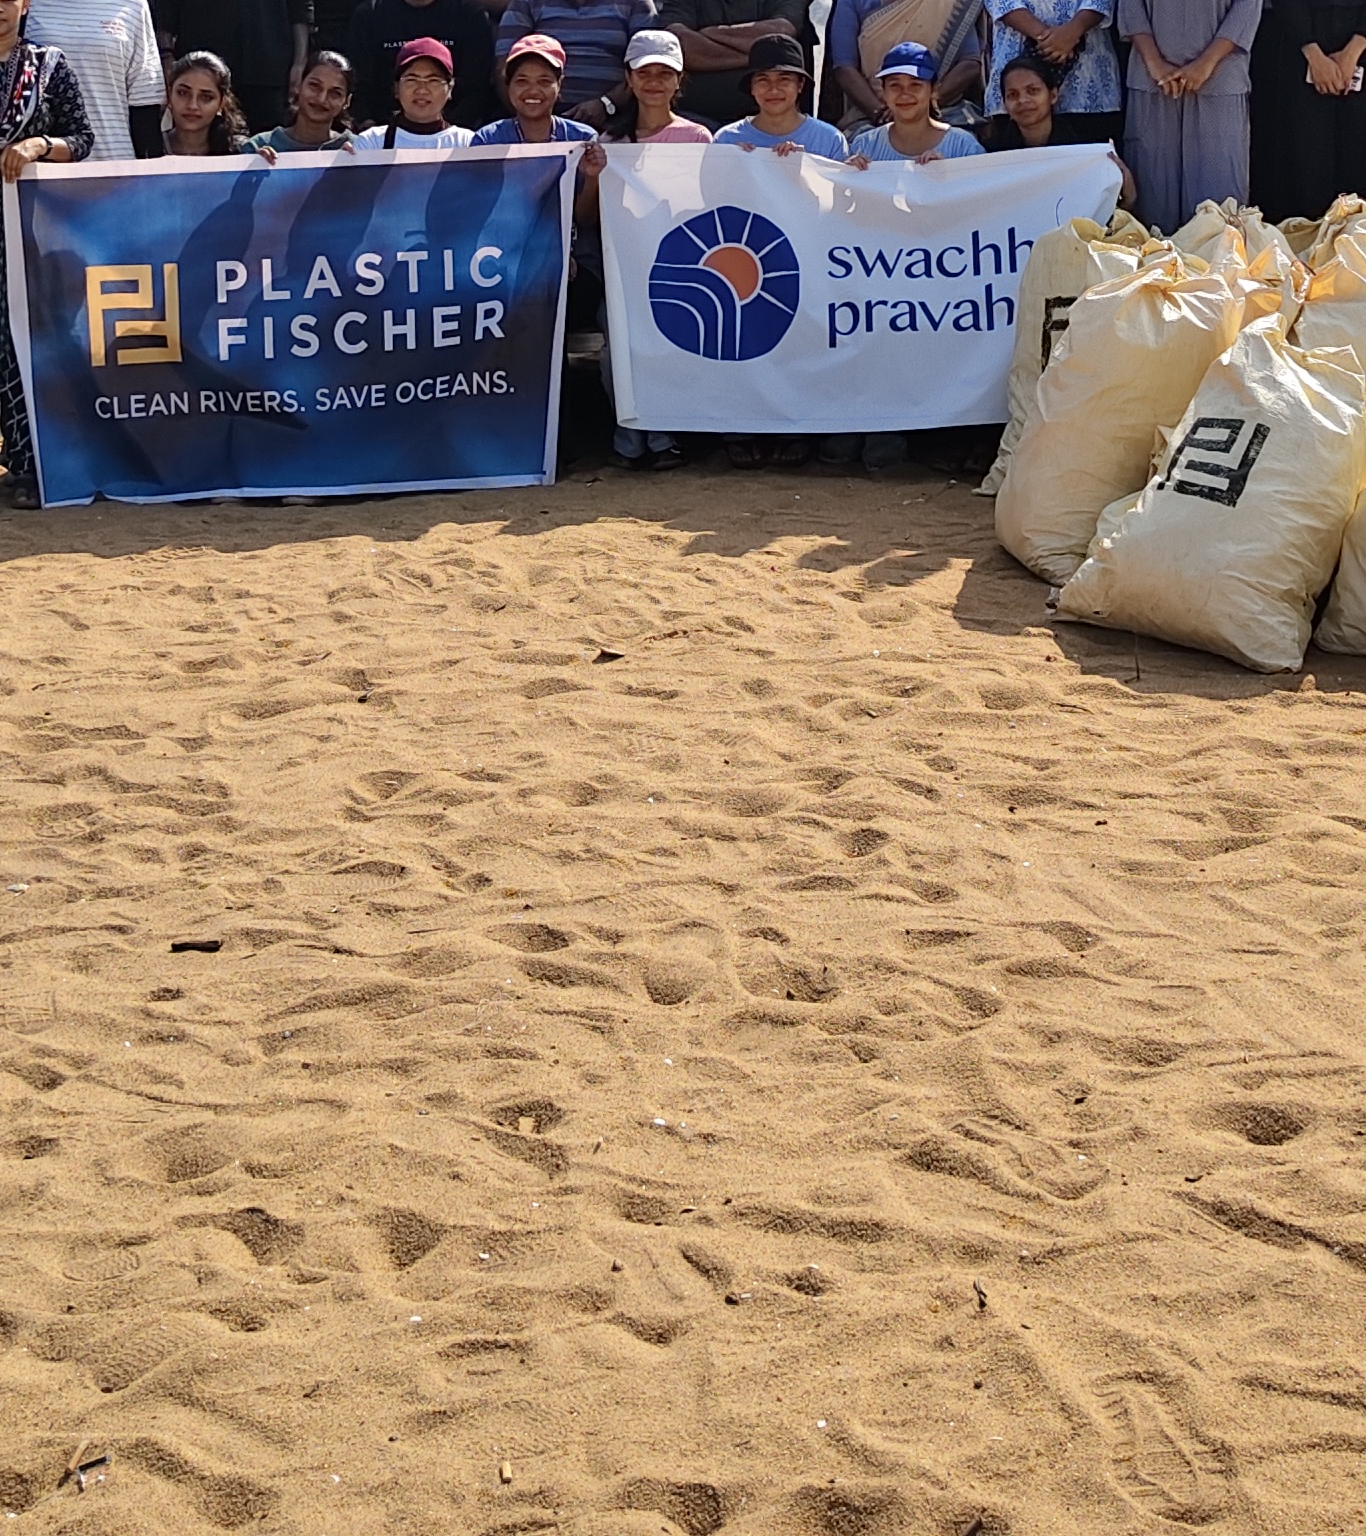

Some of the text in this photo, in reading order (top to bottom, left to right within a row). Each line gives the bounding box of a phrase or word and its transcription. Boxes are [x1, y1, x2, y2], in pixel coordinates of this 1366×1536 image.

[216, 245, 504, 305] PLASTIC
[827, 226, 1034, 280] swachh
[217, 299, 507, 362] FISCHER
[828, 282, 1016, 349] pravah
[94, 370, 515, 420] CLEAN RIVERS. SAVE OCEANS.
